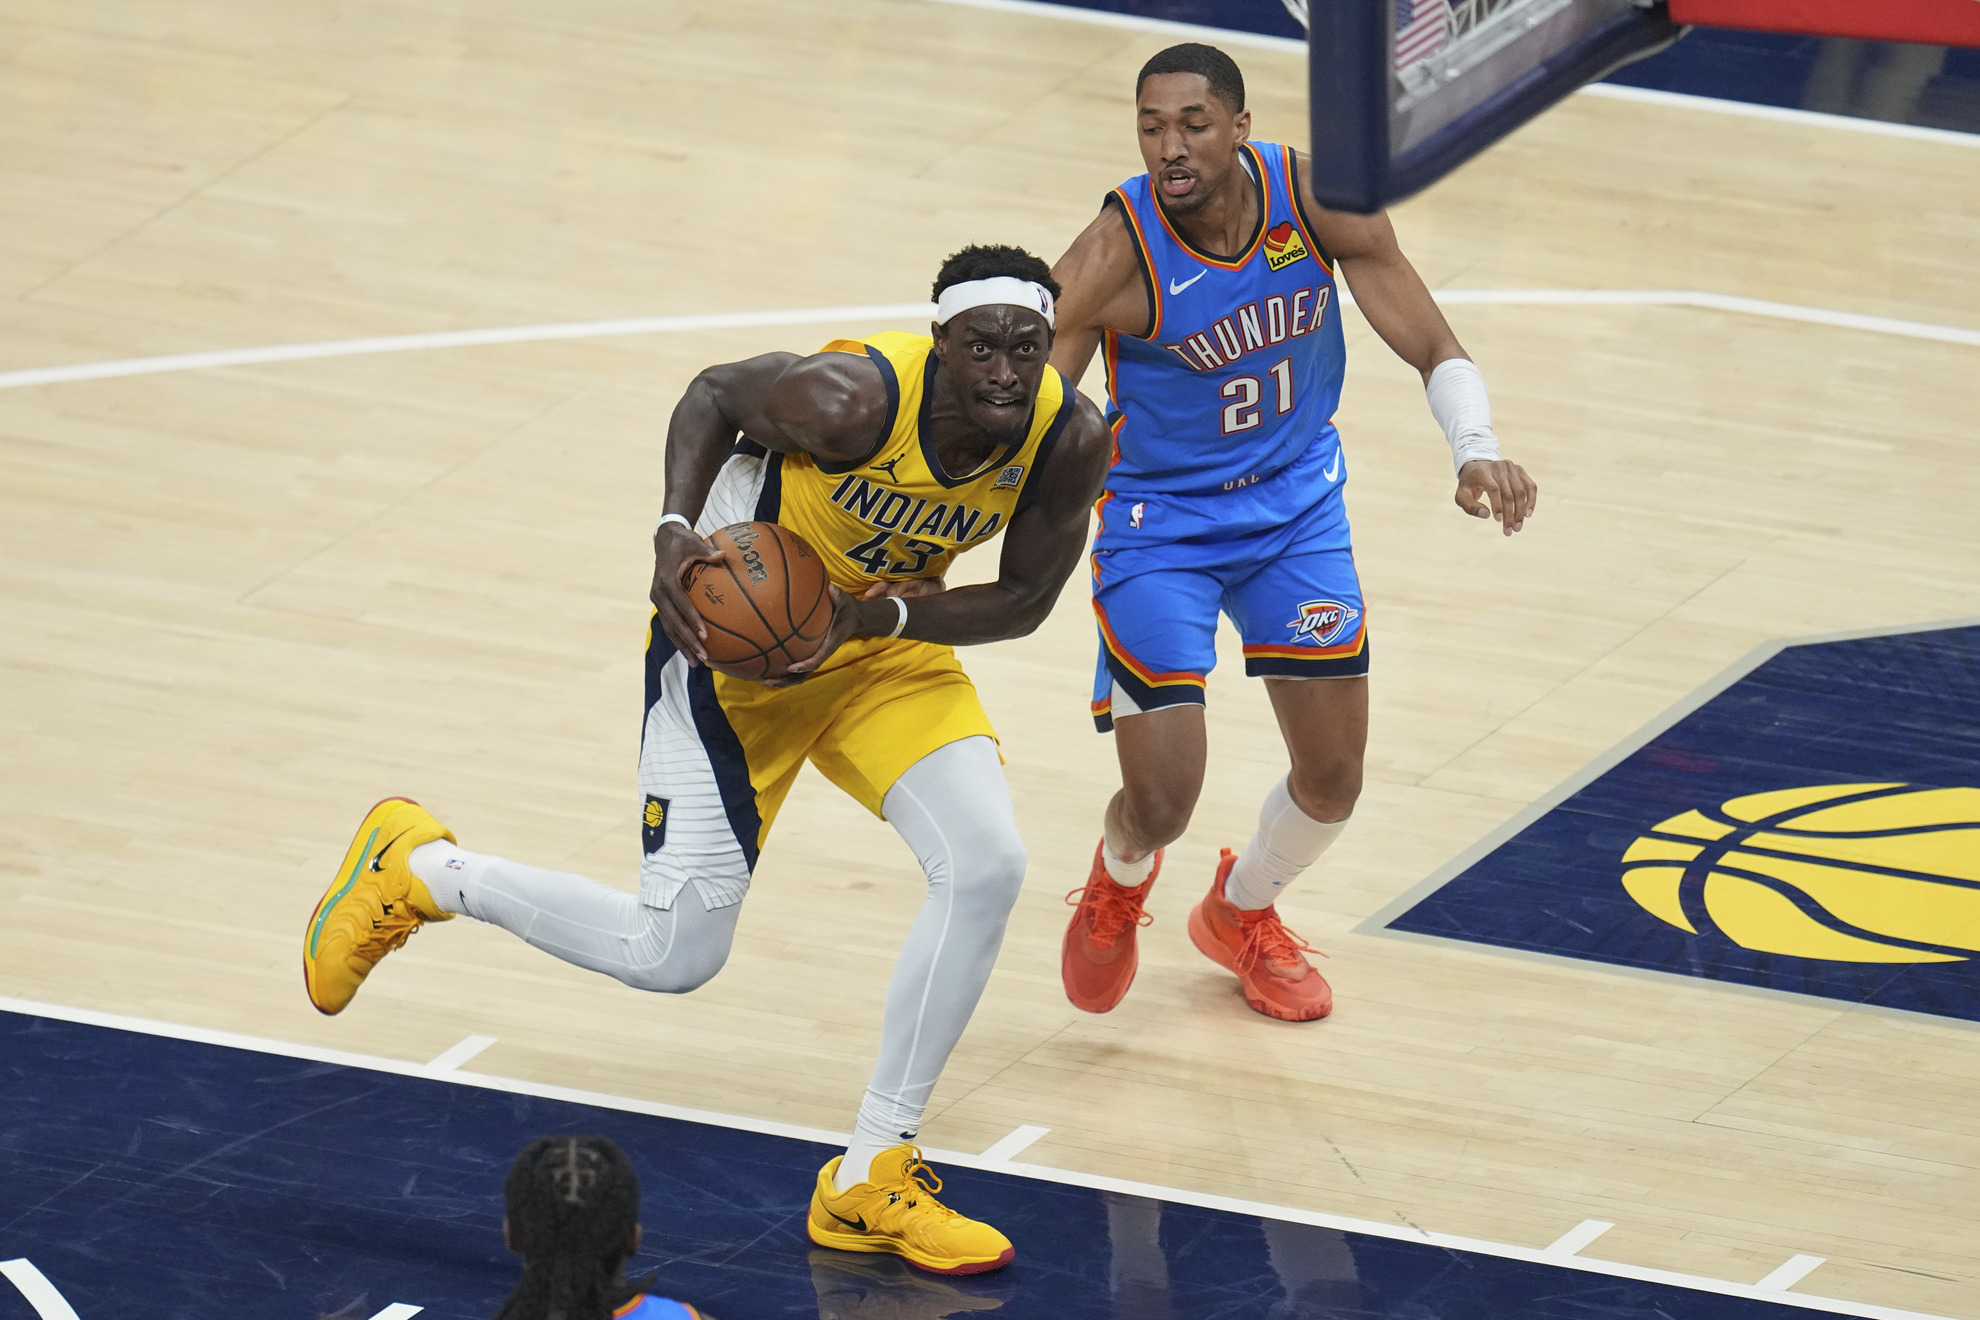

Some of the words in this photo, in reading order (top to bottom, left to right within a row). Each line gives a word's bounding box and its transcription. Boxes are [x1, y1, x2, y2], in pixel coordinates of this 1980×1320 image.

[1163, 284, 1331, 373] THUNDER
[1220, 356, 1295, 436] 21
[830, 473, 1003, 543] INDIANA
[844, 530, 947, 576] 43
[1298, 609, 1339, 635] OKC
